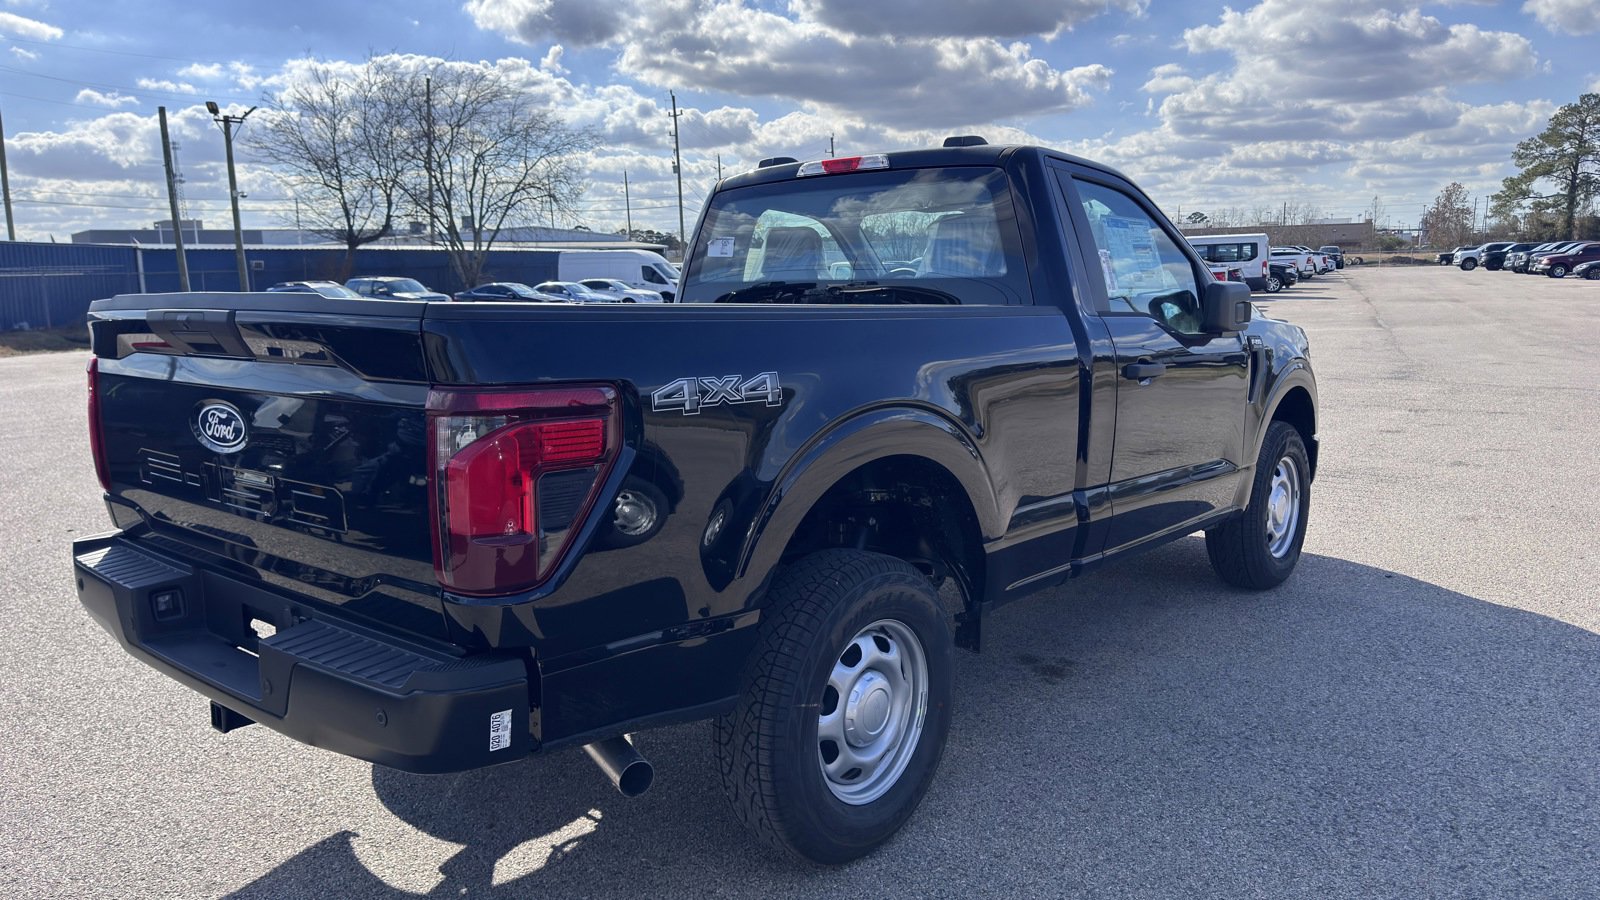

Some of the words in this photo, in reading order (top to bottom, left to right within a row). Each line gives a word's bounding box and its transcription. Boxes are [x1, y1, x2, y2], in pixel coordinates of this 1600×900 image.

[206, 410, 235, 440] Ford
[138, 448, 348, 534] F-150
[491, 714, 501, 733] 4076
[491, 734, 501, 750] 020
